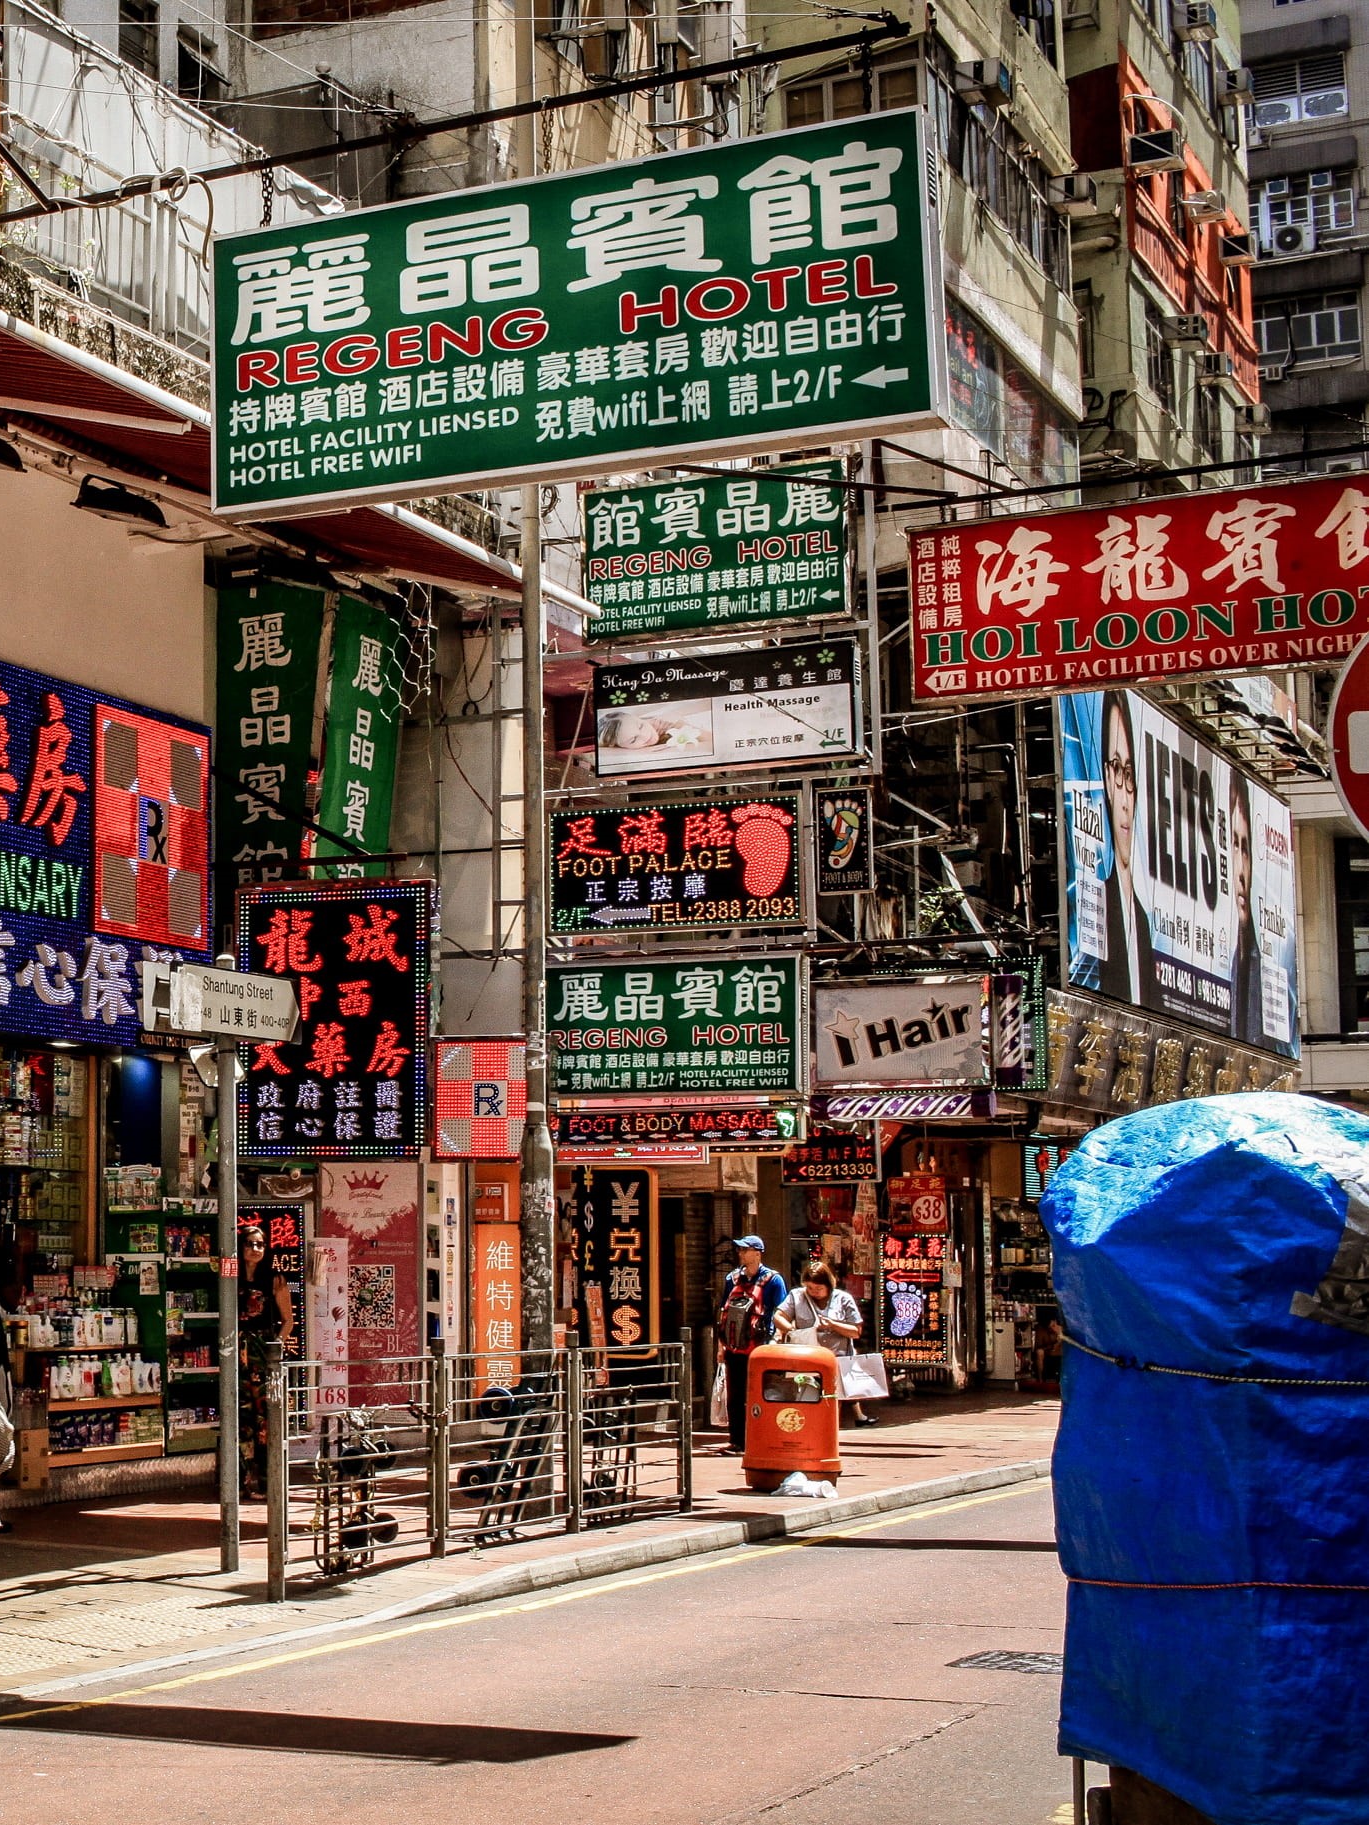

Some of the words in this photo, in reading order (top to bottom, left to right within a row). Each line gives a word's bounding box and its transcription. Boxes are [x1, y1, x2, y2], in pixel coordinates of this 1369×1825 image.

[231, 141, 903, 345] 麗晶賓館
[236, 307, 549, 392] REGENG
[618, 254, 898, 334] HOTEL
[229, 380, 368, 437] 持牌賓館
[377, 358, 526, 416] 酒店設備
[536, 332, 690, 392] 豪華套房
[701, 303, 906, 368] 歡迎自由行
[535, 379, 711, 443] 免費wifi上網
[728, 365, 843, 416] 請上2/F
[229, 437, 304, 464] HOTEL
[310, 421, 413, 454] FACILITY
[419, 407, 520, 437] LIENSED
[229, 460, 304, 488] HOTEL
[311, 451, 364, 477] FREE
[370, 444, 422, 468] WIFI
[589, 546, 713, 581] REGENG
[737, 529, 839, 564] HOTEL
[589, 579, 645, 605] 持牌賓館
[647, 573, 705, 600] 酒店設備
[707, 565, 765, 593] 豪華套房
[767, 556, 840, 585] 歡迎自由行
[916, 537, 938, 630] 酒店設備
[941, 534, 964, 628] 純粹租房
[594, 605, 621, 621] OTEL
[622, 603, 662, 617] FACILITY
[663, 599, 702, 613] LIENSED
[776, 587, 818, 612] 請上2/F
[590, 619, 621, 634] HOTEL
[622, 617, 644, 630] FREE
[645, 615, 666, 628] WIFI
[921, 622, 1043, 669] HOI
[1055, 600, 1239, 655] LOON
[1253, 586, 1369, 636] HO
[641, 670, 665, 685] Da
[667, 667, 729, 685] Massage
[729, 667, 843, 692] 慶達養生館
[975, 664, 1059, 689] HOTEL
[1063, 649, 1203, 681] FACILITEIS
[1208, 641, 1280, 666] OVER
[934, 672, 966, 689] 1/F
[724, 699, 764, 713] Health
[766, 694, 821, 709] Massage
[734, 732, 805, 749] 正宗穴位按摩
[823, 726, 845, 741] 1/F
[1071, 788, 1105, 844] Hazal
[1144, 729, 1220, 911] IELTS
[1074, 834, 1096, 874] Wong
[1264, 822, 1291, 857] MODERN
[558, 856, 623, 878] FOOT
[629, 849, 732, 875] PALACE
[585, 872, 707, 902] 正宗按摩
[556, 907, 591, 928] 2/F
[746, 897, 796, 919] 2093
[256, 903, 411, 974] 龍城
[202, 975, 245, 999] Shantung
[246, 982, 274, 1001] Street
[553, 964, 786, 1022] 麗晶賓館
[219, 1004, 258, 1029] 山東街
[866, 1001, 973, 1061] Hair
[550, 1027, 668, 1051] REGENG
[692, 1022, 791, 1047] HOTEL
[605, 1052, 660, 1069] 酒店設備
[662, 1050, 718, 1067] 豪華套房
[720, 1048, 791, 1066] 歡迎自由行
[679, 1069, 709, 1080] HOTEL
[710, 1068, 750, 1079] FACILITY
[751, 1067, 789, 1078] LIENSED
[636, 1070, 675, 1089] 請上2/F
[679, 1078, 722, 1089] HOTEL
[725, 1077, 756, 1088] FREE
[758, 1077, 789, 1087] WIFI
[256, 1110, 404, 1141] 信心保證
[568, 1117, 617, 1134] FOOT
[620, 1117, 631, 1133] &
[635, 1115, 685, 1132] BODY
[689, 1113, 778, 1131] MASSAGE
[807, 1162, 874, 1177] 62213330
[386, 1333, 405, 1353] BL
[315, 1387, 347, 1405] 168
